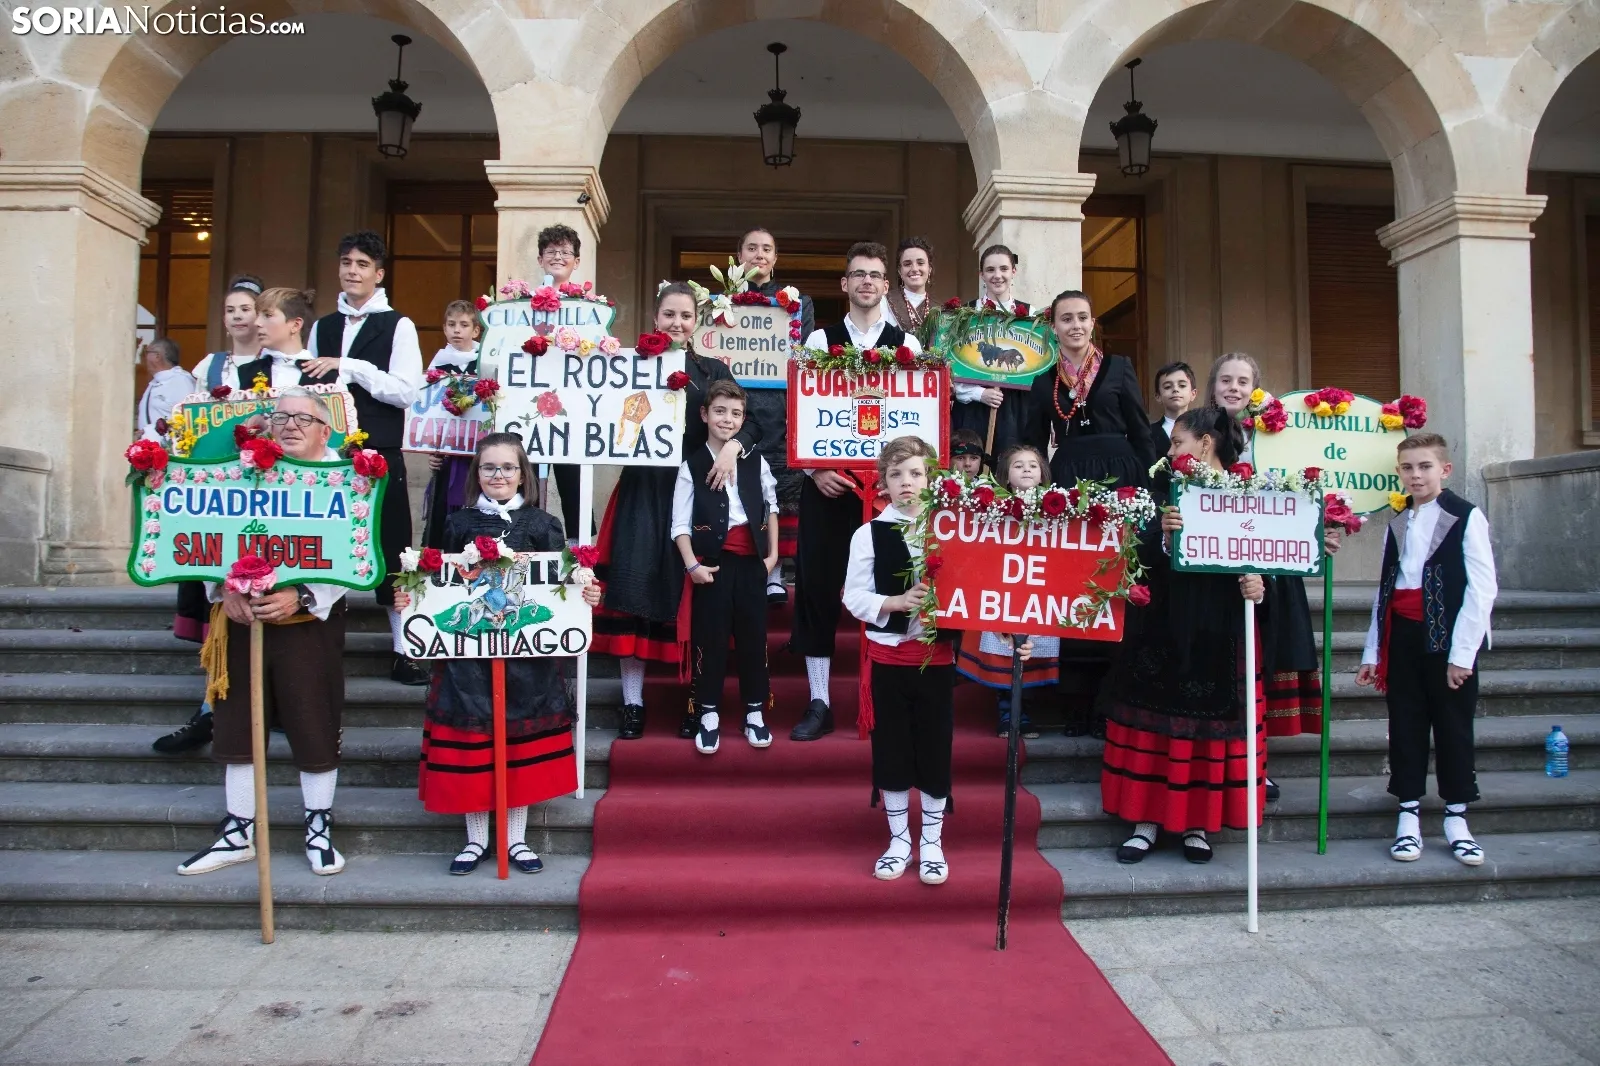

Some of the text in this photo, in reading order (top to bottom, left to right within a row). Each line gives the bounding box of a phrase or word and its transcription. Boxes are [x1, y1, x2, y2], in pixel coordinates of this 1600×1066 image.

[701, 330, 787, 353] Clemente
[508, 352, 550, 388] EL
[210, 401, 258, 428] CRUZ
[586, 393, 603, 418] Y
[815, 407, 852, 429] DE
[584, 422, 674, 459] BLAS
[1323, 442, 1347, 461] de
[163, 486, 347, 519] CUADRILLA
[1200, 493, 1296, 516] CUADRILLA
[240, 518, 268, 534] de
[933, 509, 1121, 553] CUADRILLA
[1239, 518, 1256, 533] de
[173, 531, 333, 570] SAN MIGUEL
[1186, 534, 1311, 564] STA. BÁRBARA
[1002, 552, 1047, 586] DE
[403, 613, 587, 658] SANTIAGO
